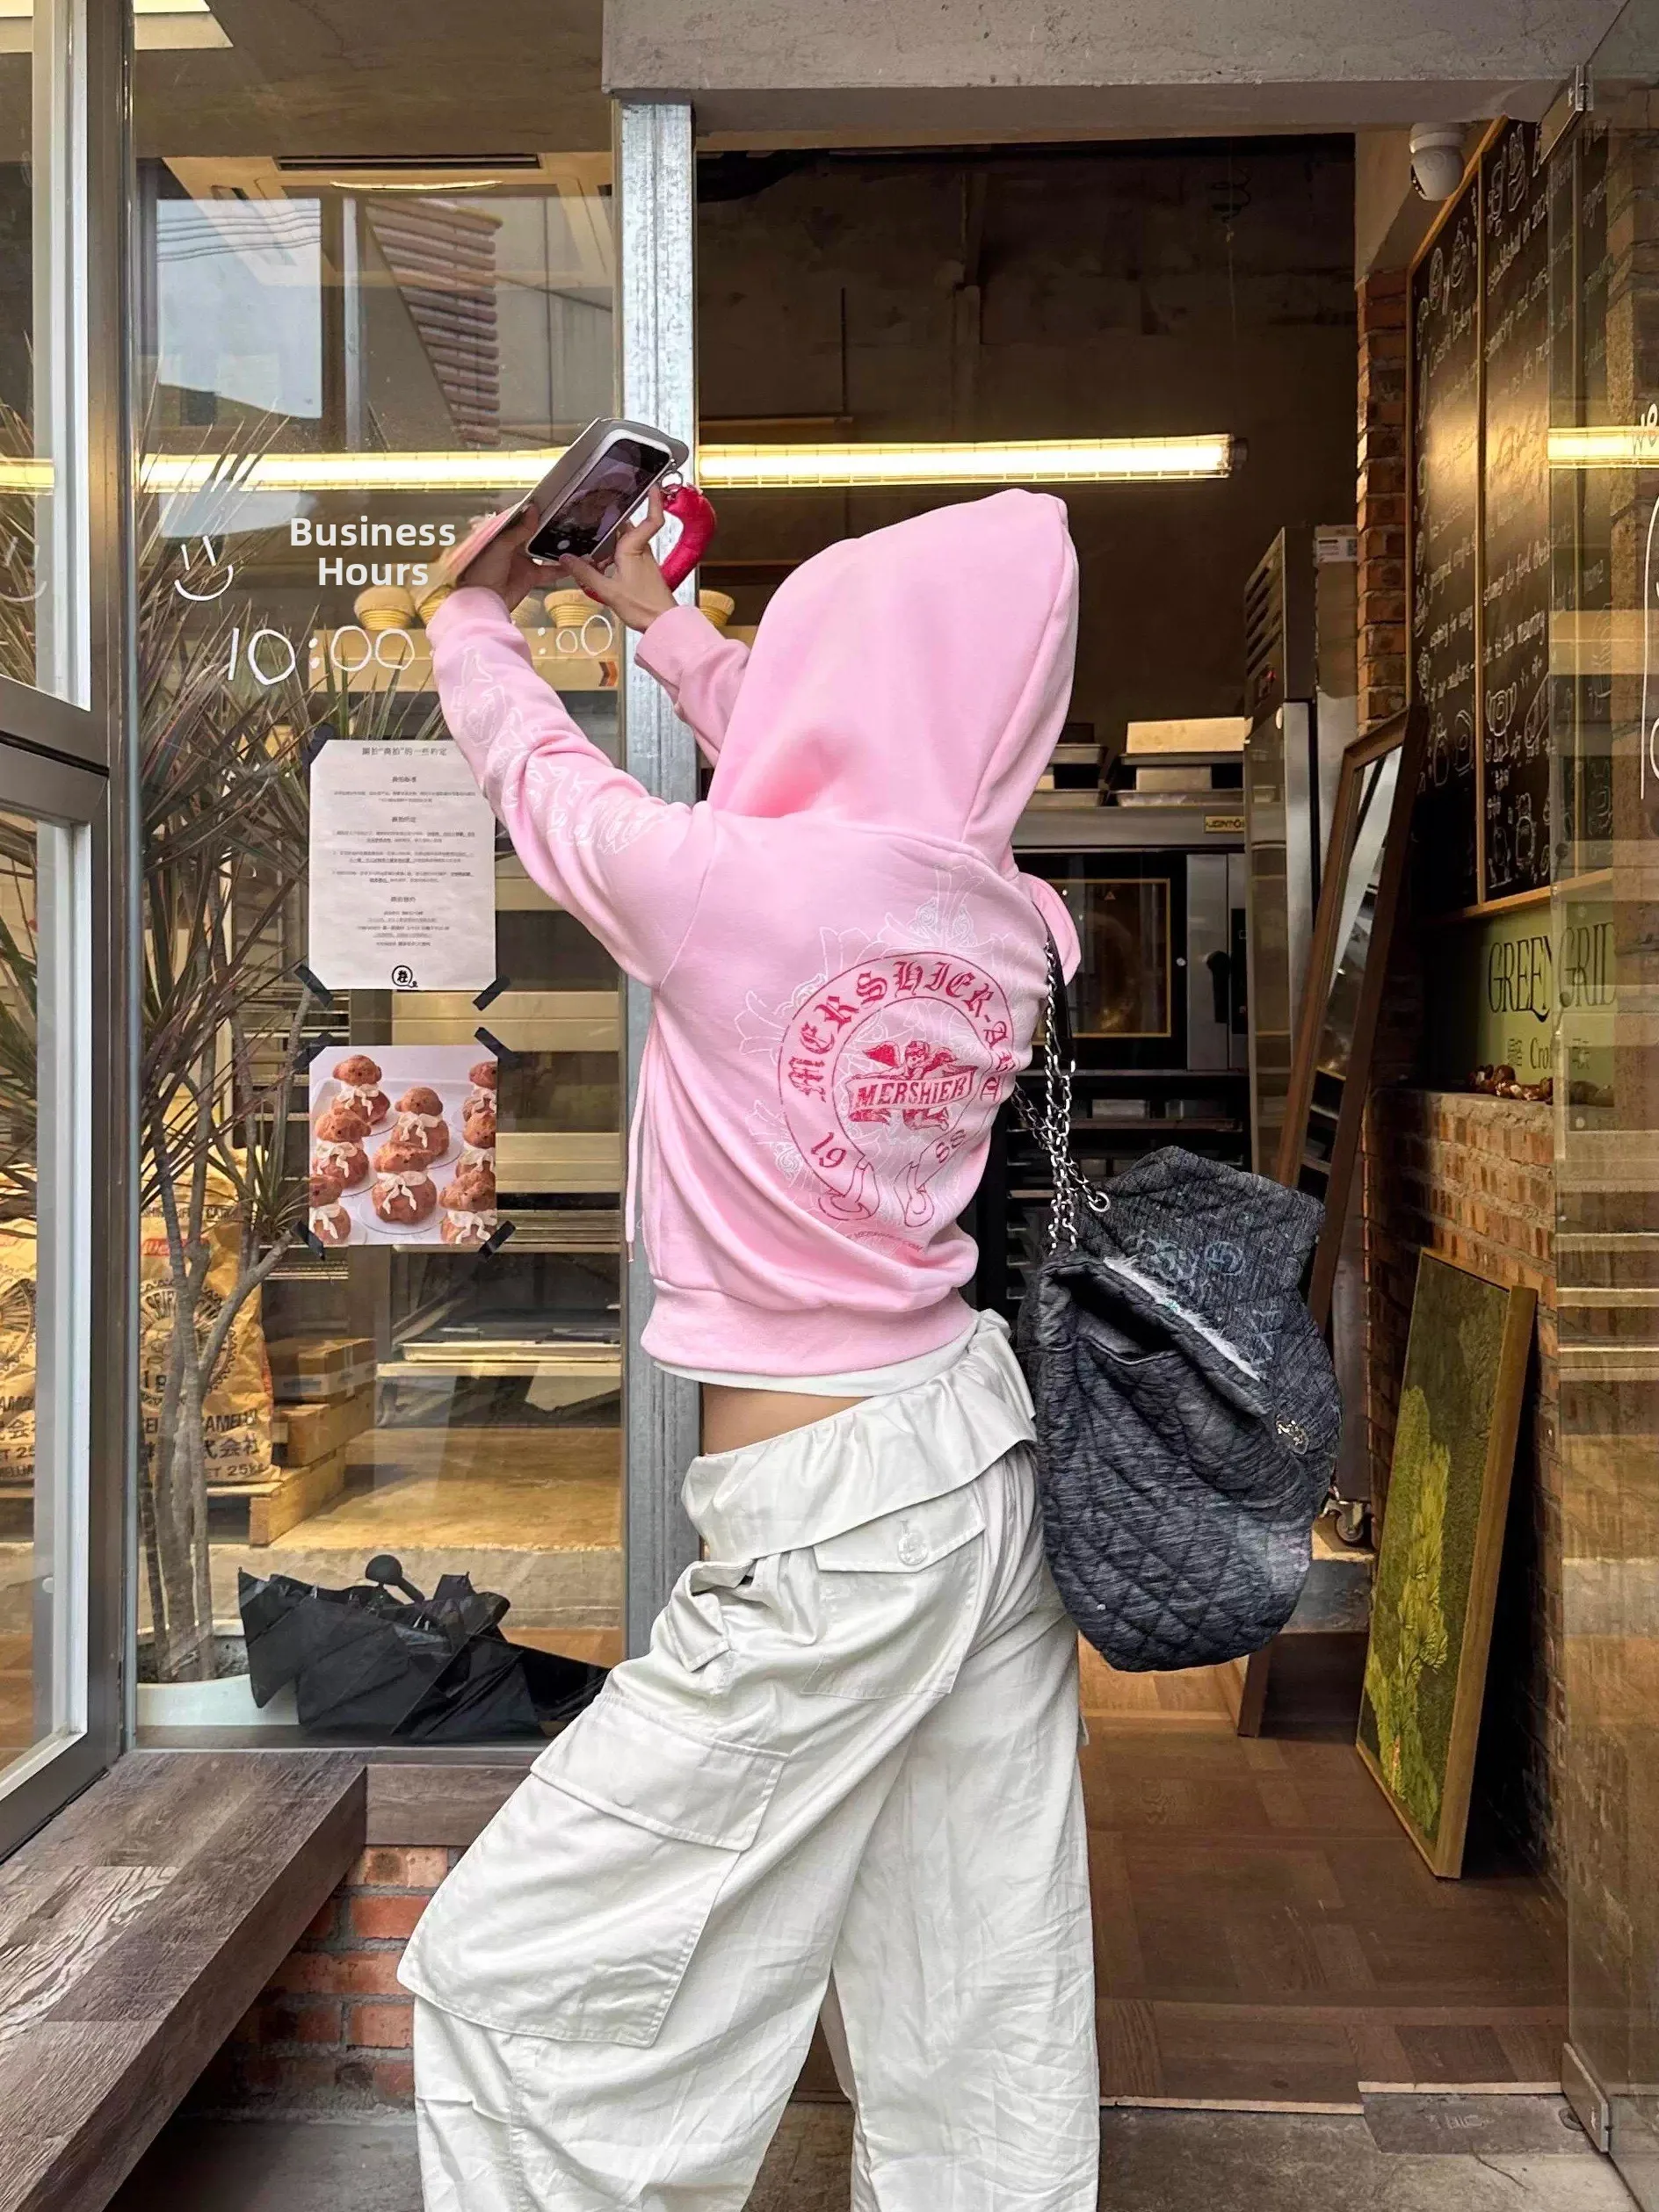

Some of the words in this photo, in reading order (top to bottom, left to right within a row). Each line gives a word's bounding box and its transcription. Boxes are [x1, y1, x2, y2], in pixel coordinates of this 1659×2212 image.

[291, 516, 456, 546] Business
[318, 557, 429, 586] Hours
[228, 625, 416, 685] 10:00
[855, 1076, 968, 1108] MERSHIER
